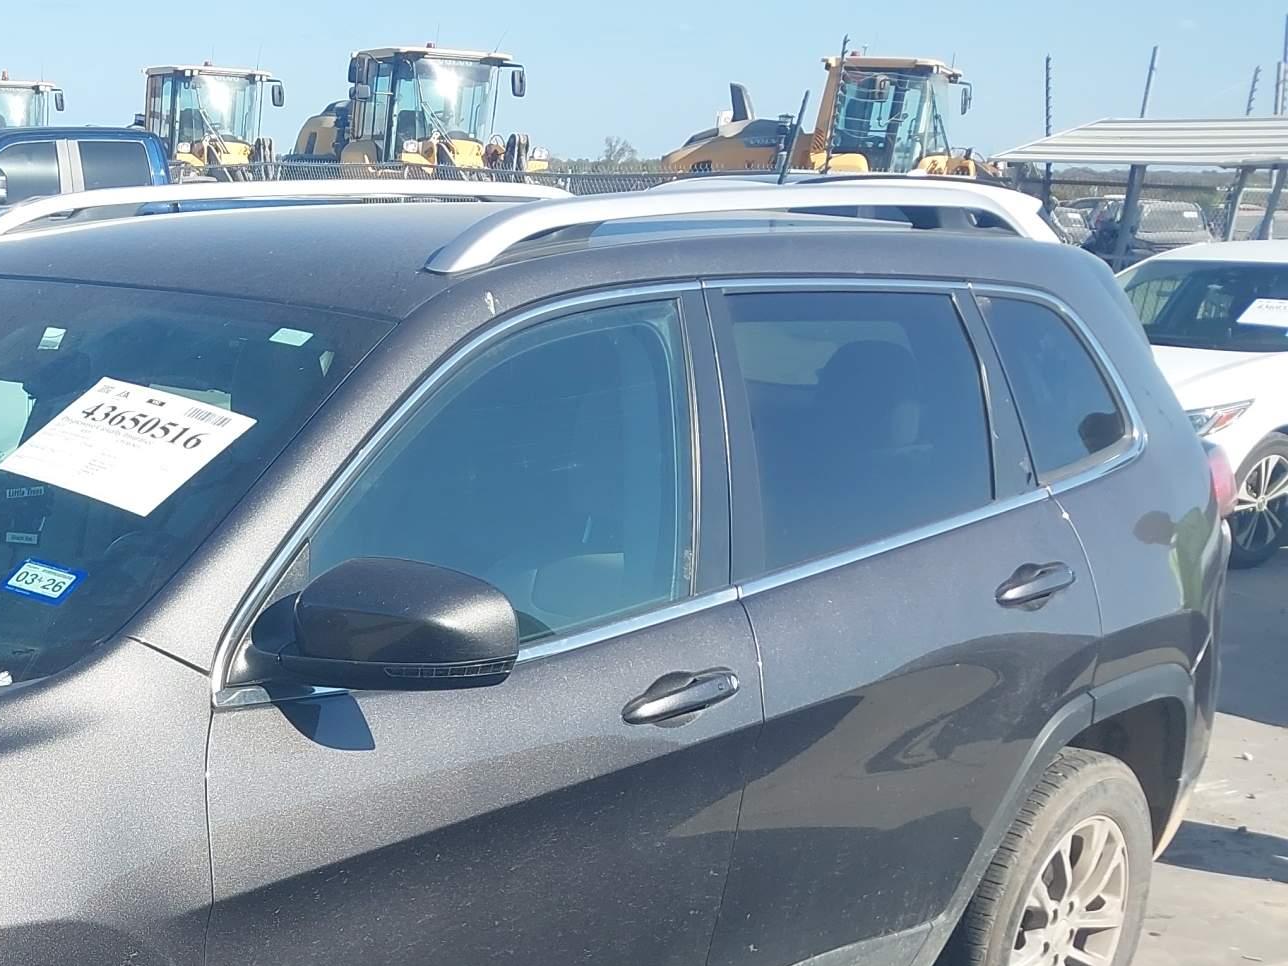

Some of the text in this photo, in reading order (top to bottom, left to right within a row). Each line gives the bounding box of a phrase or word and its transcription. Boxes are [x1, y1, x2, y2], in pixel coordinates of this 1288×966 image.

[82, 402, 208, 450] 43650516
[15, 570, 39, 585] 03
[40, 578, 66, 593] 26
